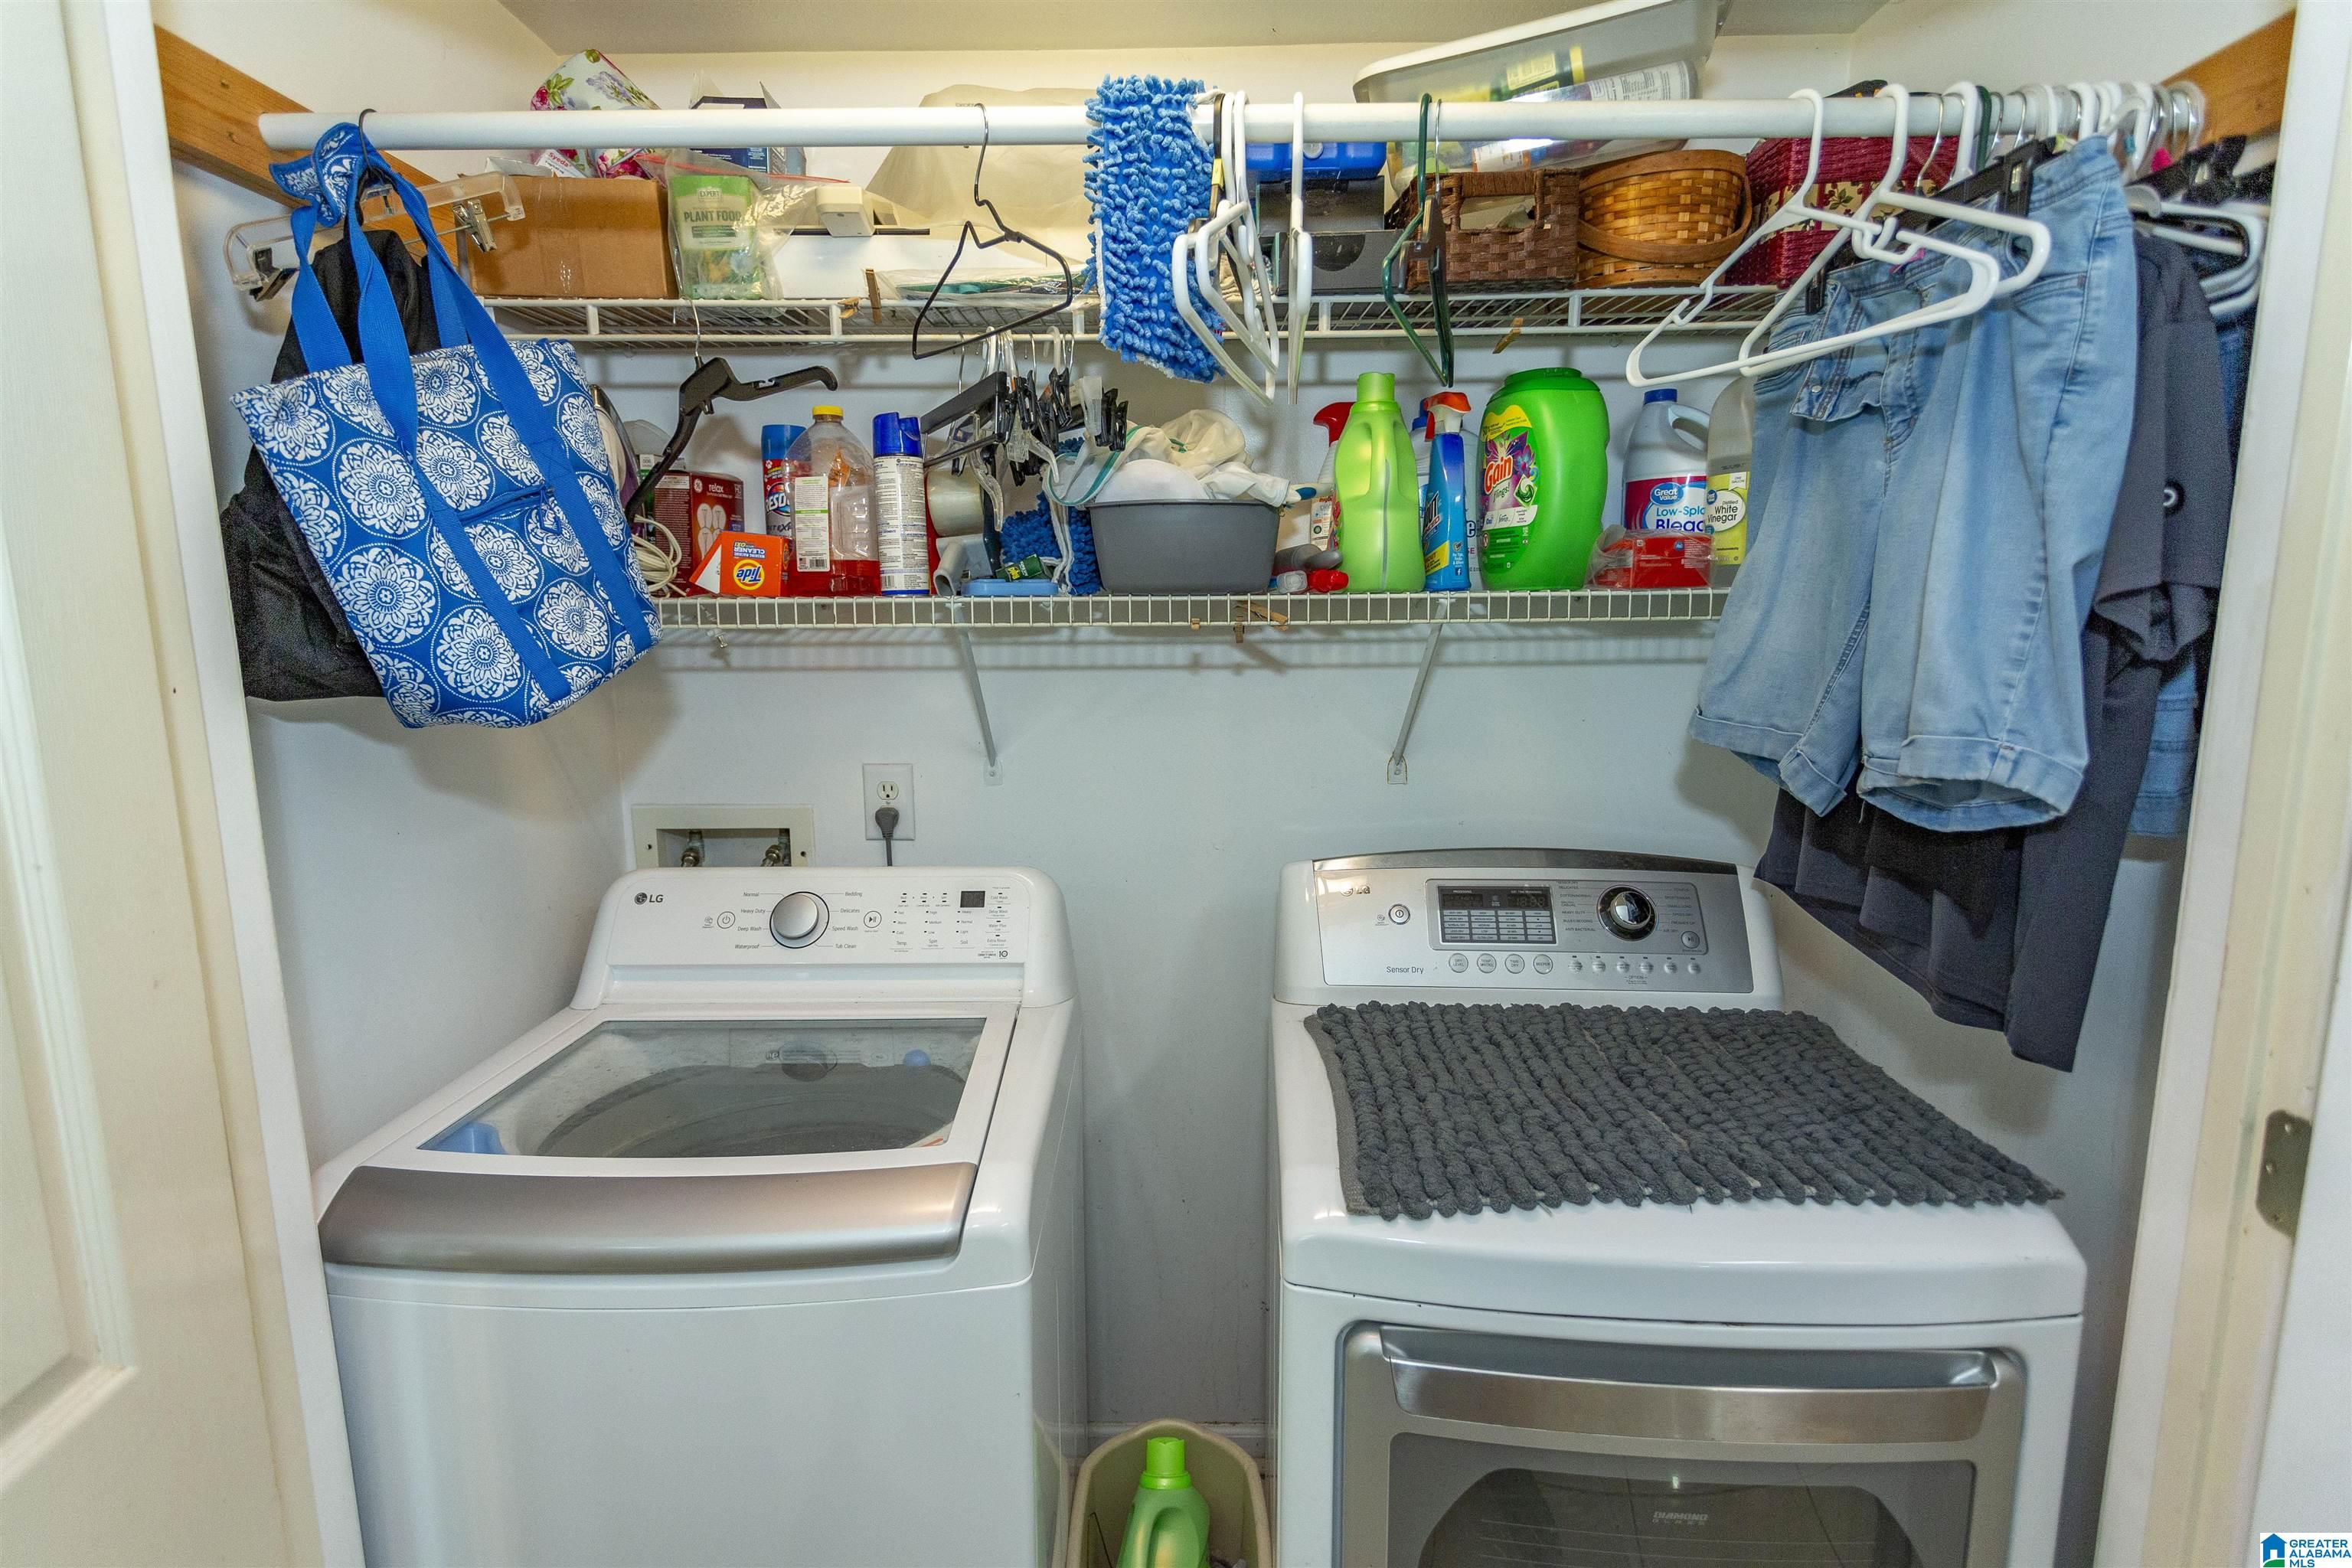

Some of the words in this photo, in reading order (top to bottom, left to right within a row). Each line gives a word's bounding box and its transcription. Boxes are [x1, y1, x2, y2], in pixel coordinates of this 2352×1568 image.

[684, 211, 714, 222] PLANT
[717, 211, 741, 221] FOOD
[1485, 456, 1513, 494] Gain
[708, 483, 724, 492] relax
[1655, 488, 1678, 497] Great
[1715, 505, 1738, 515] White
[1707, 514, 1738, 524] Vinegar
[1656, 518, 1705, 532] Bleac
[733, 546, 766, 554] CLEANER
[736, 565, 762, 583] Tide
[649, 894, 664, 903] LG
